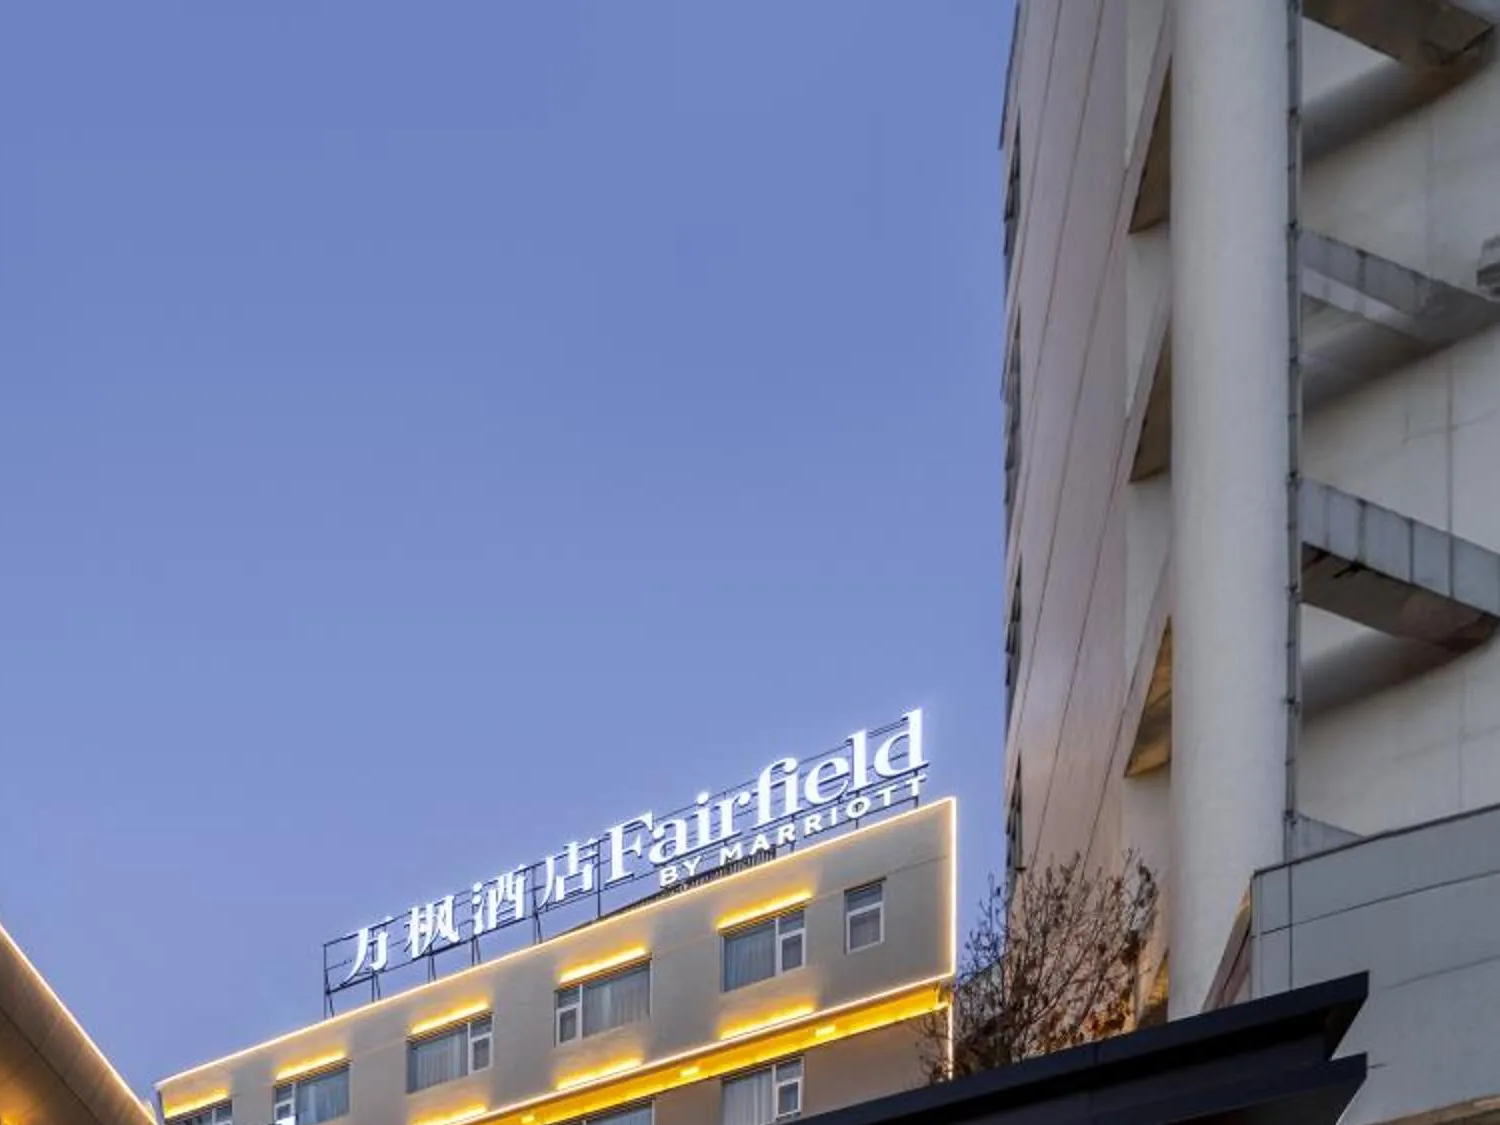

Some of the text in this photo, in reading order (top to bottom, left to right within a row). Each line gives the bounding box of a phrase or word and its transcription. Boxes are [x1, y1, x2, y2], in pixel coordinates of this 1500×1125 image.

[346, 708, 929, 982] 万枫酒店 Fairfield
[660, 776, 927, 889] BY MARRIOTT
